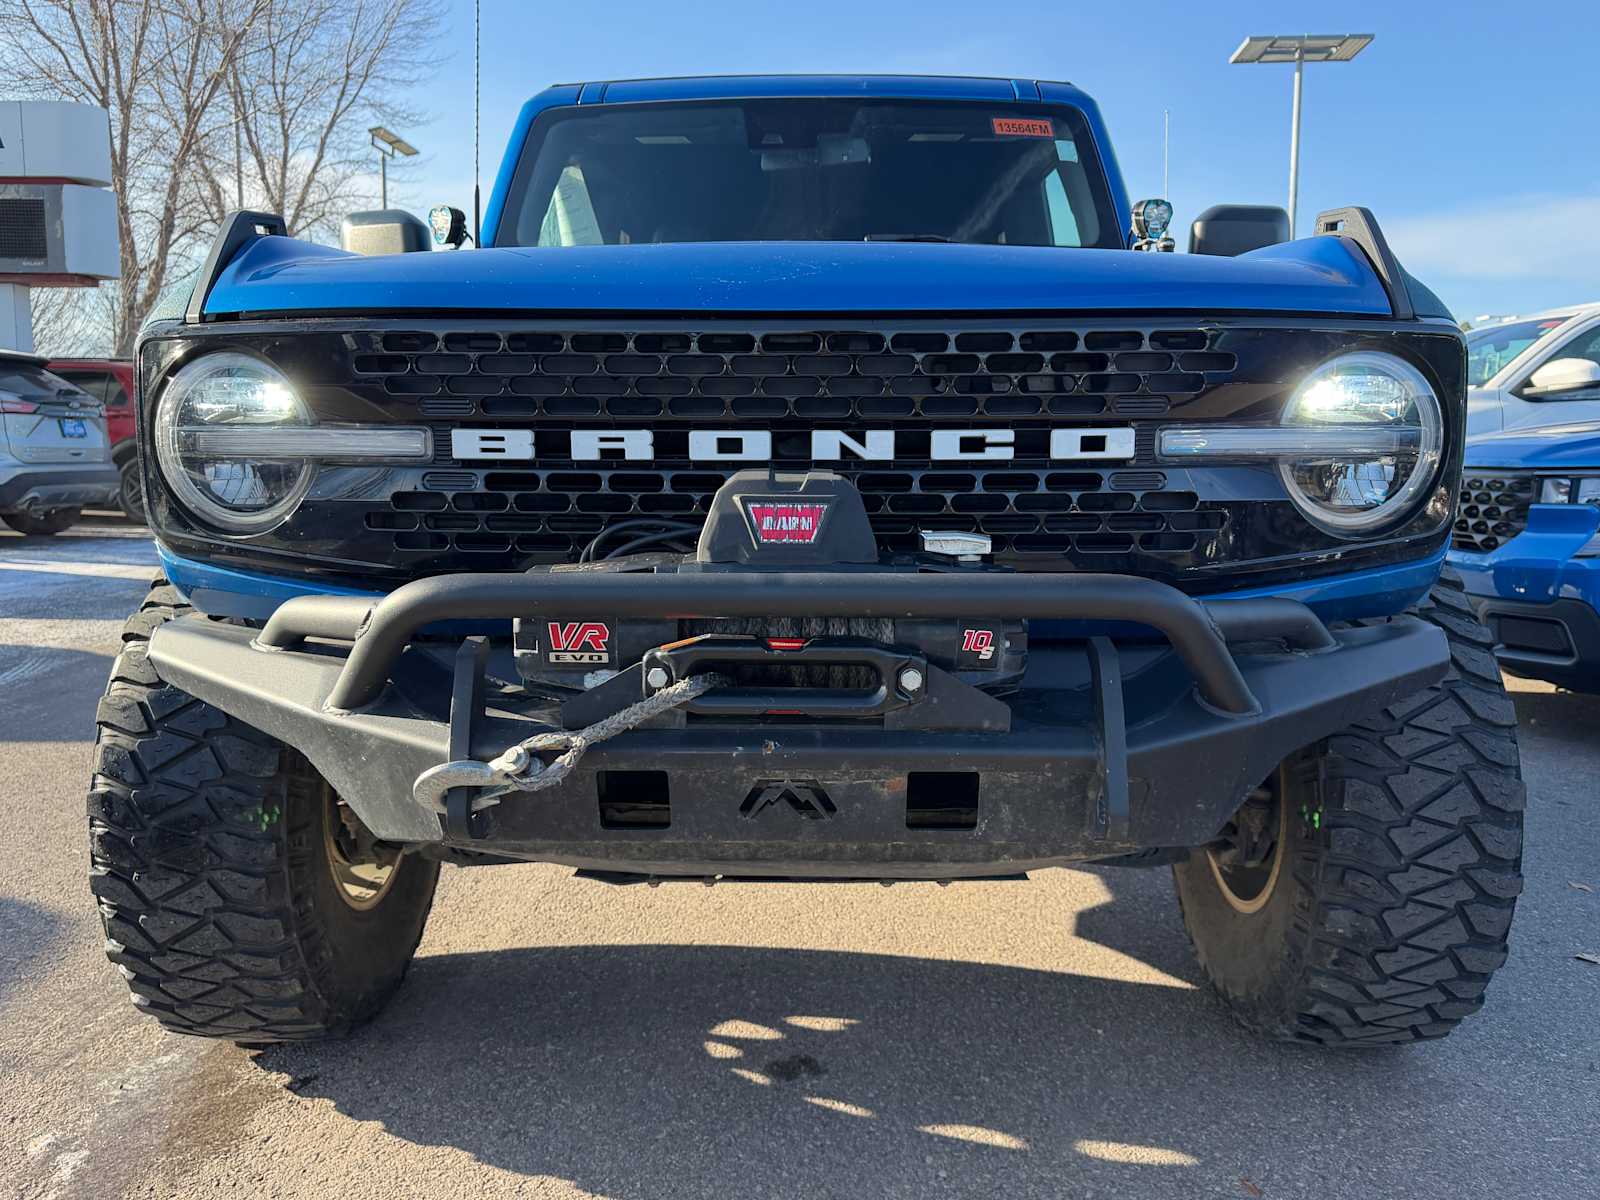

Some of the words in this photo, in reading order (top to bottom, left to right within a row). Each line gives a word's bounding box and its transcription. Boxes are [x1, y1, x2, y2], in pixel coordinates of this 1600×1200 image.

[451, 428, 1136, 461] BRONCO
[548, 622, 609, 651] VR
[552, 653, 605, 662] EVO
